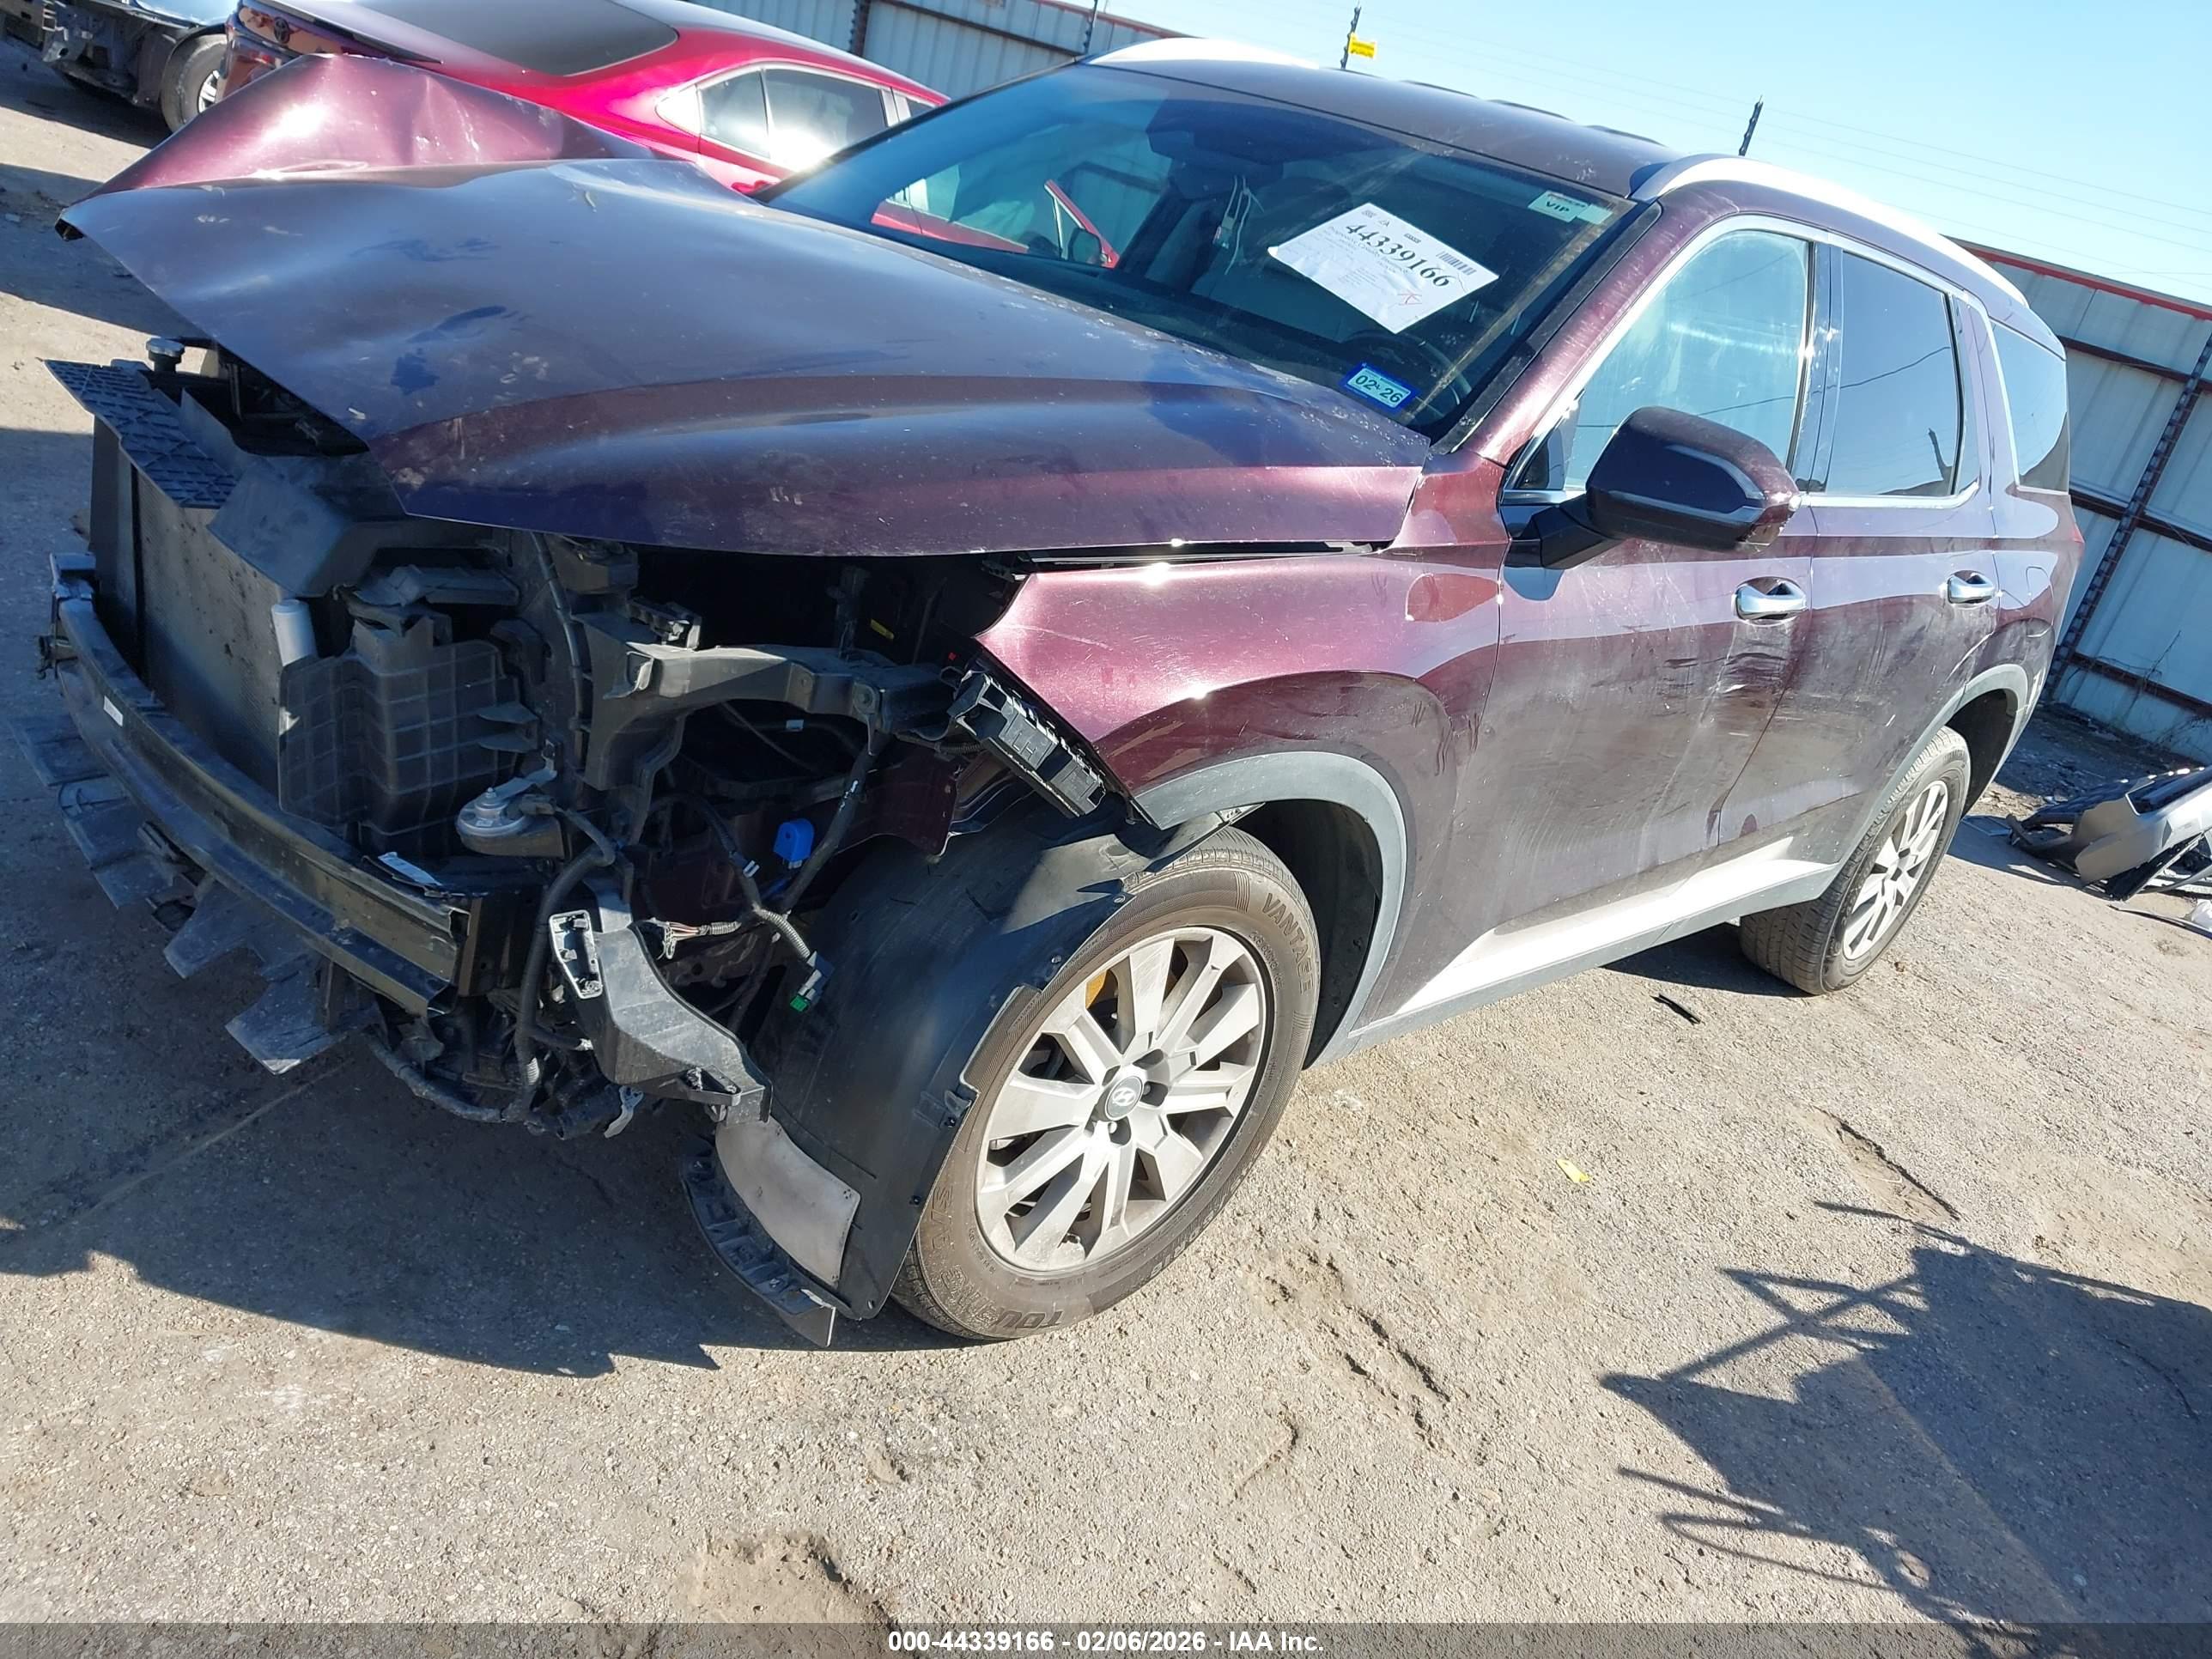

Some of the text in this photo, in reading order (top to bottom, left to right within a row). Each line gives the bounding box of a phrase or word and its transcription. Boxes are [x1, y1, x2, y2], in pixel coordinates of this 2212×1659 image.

[1546, 201, 1570, 212] VIP
[1346, 224, 1457, 287] 44339166
[1355, 374, 1404, 403] 02 26
[1261, 892, 1315, 994] VANTAGE
[940, 1265, 1064, 1330] TOURING
